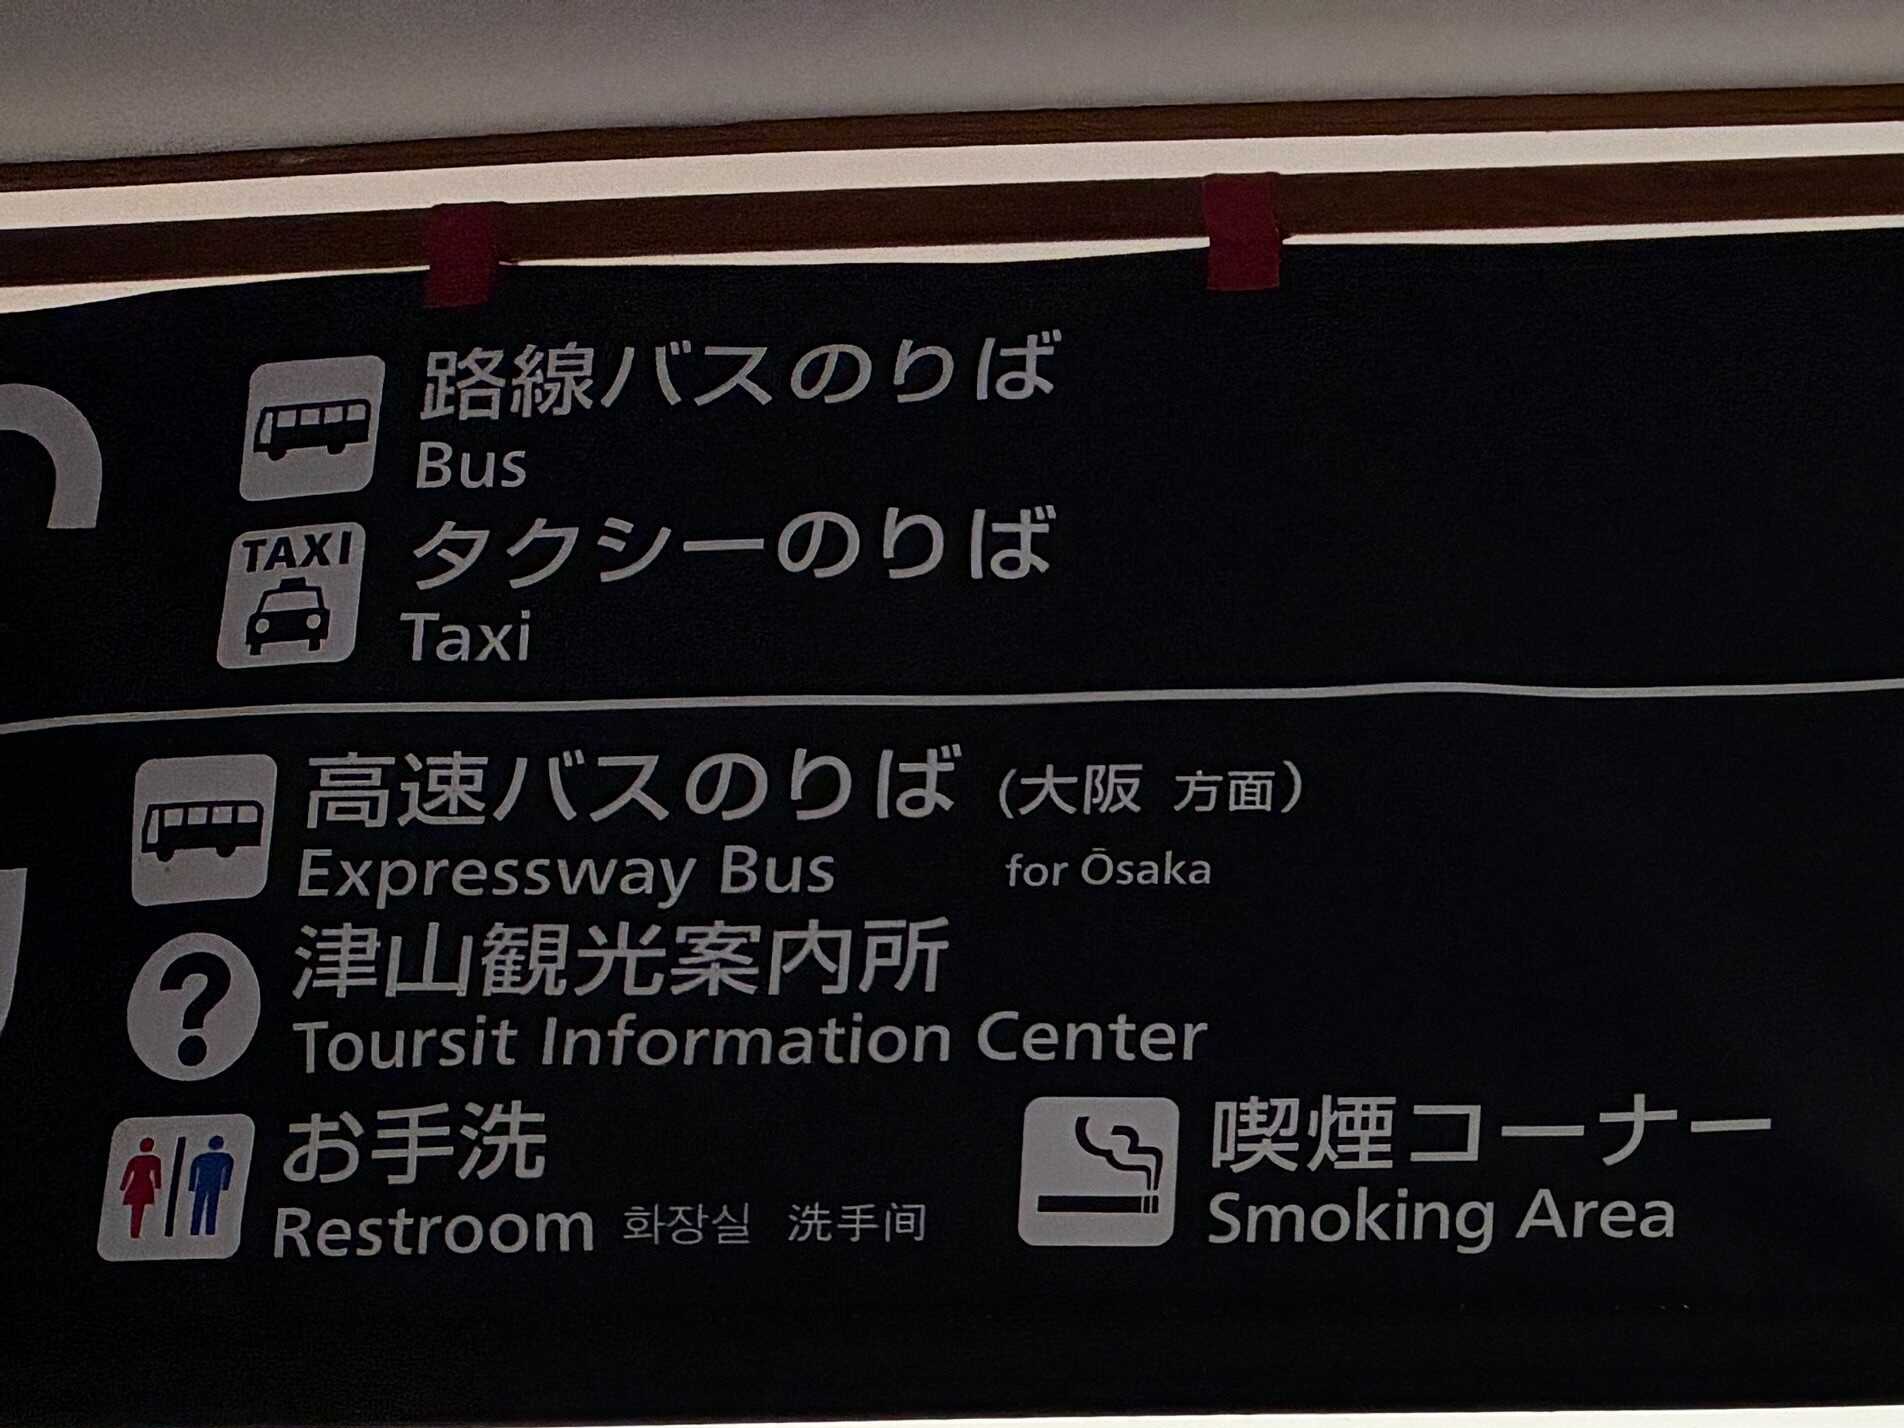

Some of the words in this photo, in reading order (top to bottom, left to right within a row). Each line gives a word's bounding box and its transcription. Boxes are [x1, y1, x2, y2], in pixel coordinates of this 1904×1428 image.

[419, 329, 1062, 420] 路線バスのりば
[415, 441, 527, 489] Bus
[241, 530, 352, 574] TAXI
[413, 505, 1056, 591] タクシーのりば
[400, 610, 531, 662] Taxi
[306, 748, 962, 829] 高速バスのりば
[298, 844, 697, 909] Expressway
[719, 843, 836, 895] Bus
[1006, 853, 1069, 889] for
[1080, 846, 1212, 887] Ōsaka
[291, 915, 950, 999] 津山観光案内所
[292, 1014, 516, 1074] Toursit
[541, 1012, 951, 1066] Information
[976, 1010, 1209, 1062] Center
[282, 1099, 547, 1185] お手洗
[1211, 1092, 1773, 1173] 喫煙コーナー
[272, 1203, 595, 1259] Restroom
[623, 1203, 751, 1246] 화장실
[787, 1203, 926, 1245] 洗手间
[1208, 1189, 1496, 1254] Smoking
[1515, 1188, 1676, 1240] Area
